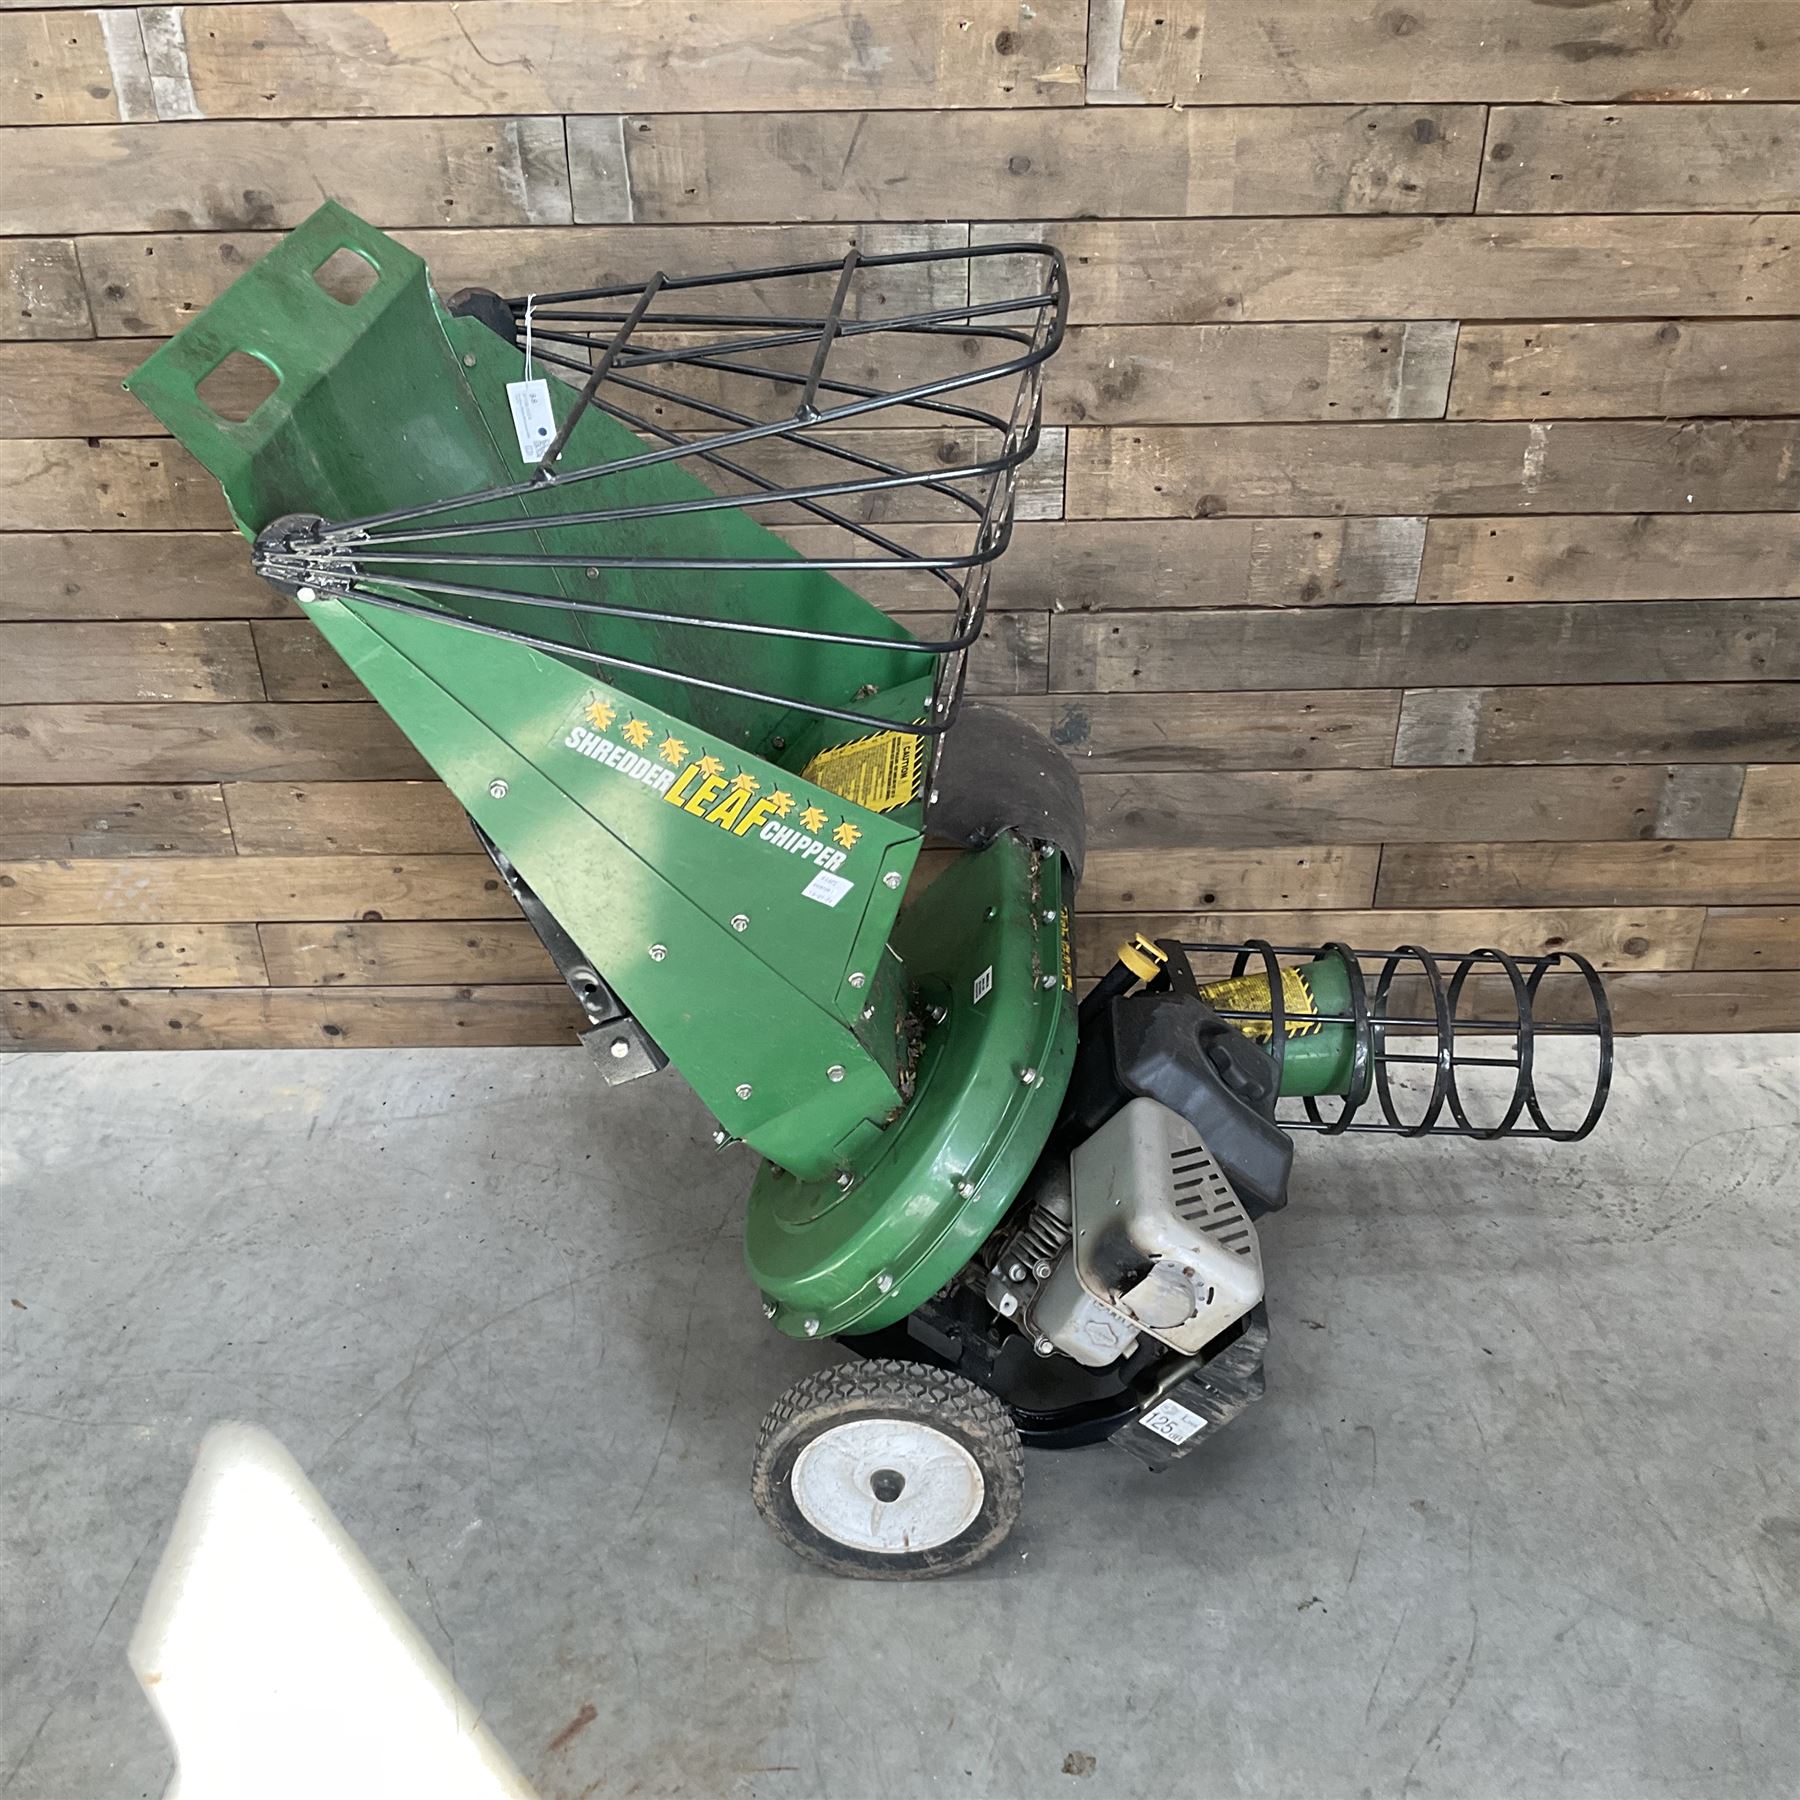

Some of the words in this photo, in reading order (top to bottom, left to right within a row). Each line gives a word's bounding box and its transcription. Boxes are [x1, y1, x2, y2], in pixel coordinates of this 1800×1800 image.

[900, 745, 911, 779] CAUTION
[565, 726, 676, 798] SHREDDER
[663, 764, 779, 837] LEAF
[759, 821, 847, 871] CHIPPER
[1146, 1412, 1178, 1433] 125
